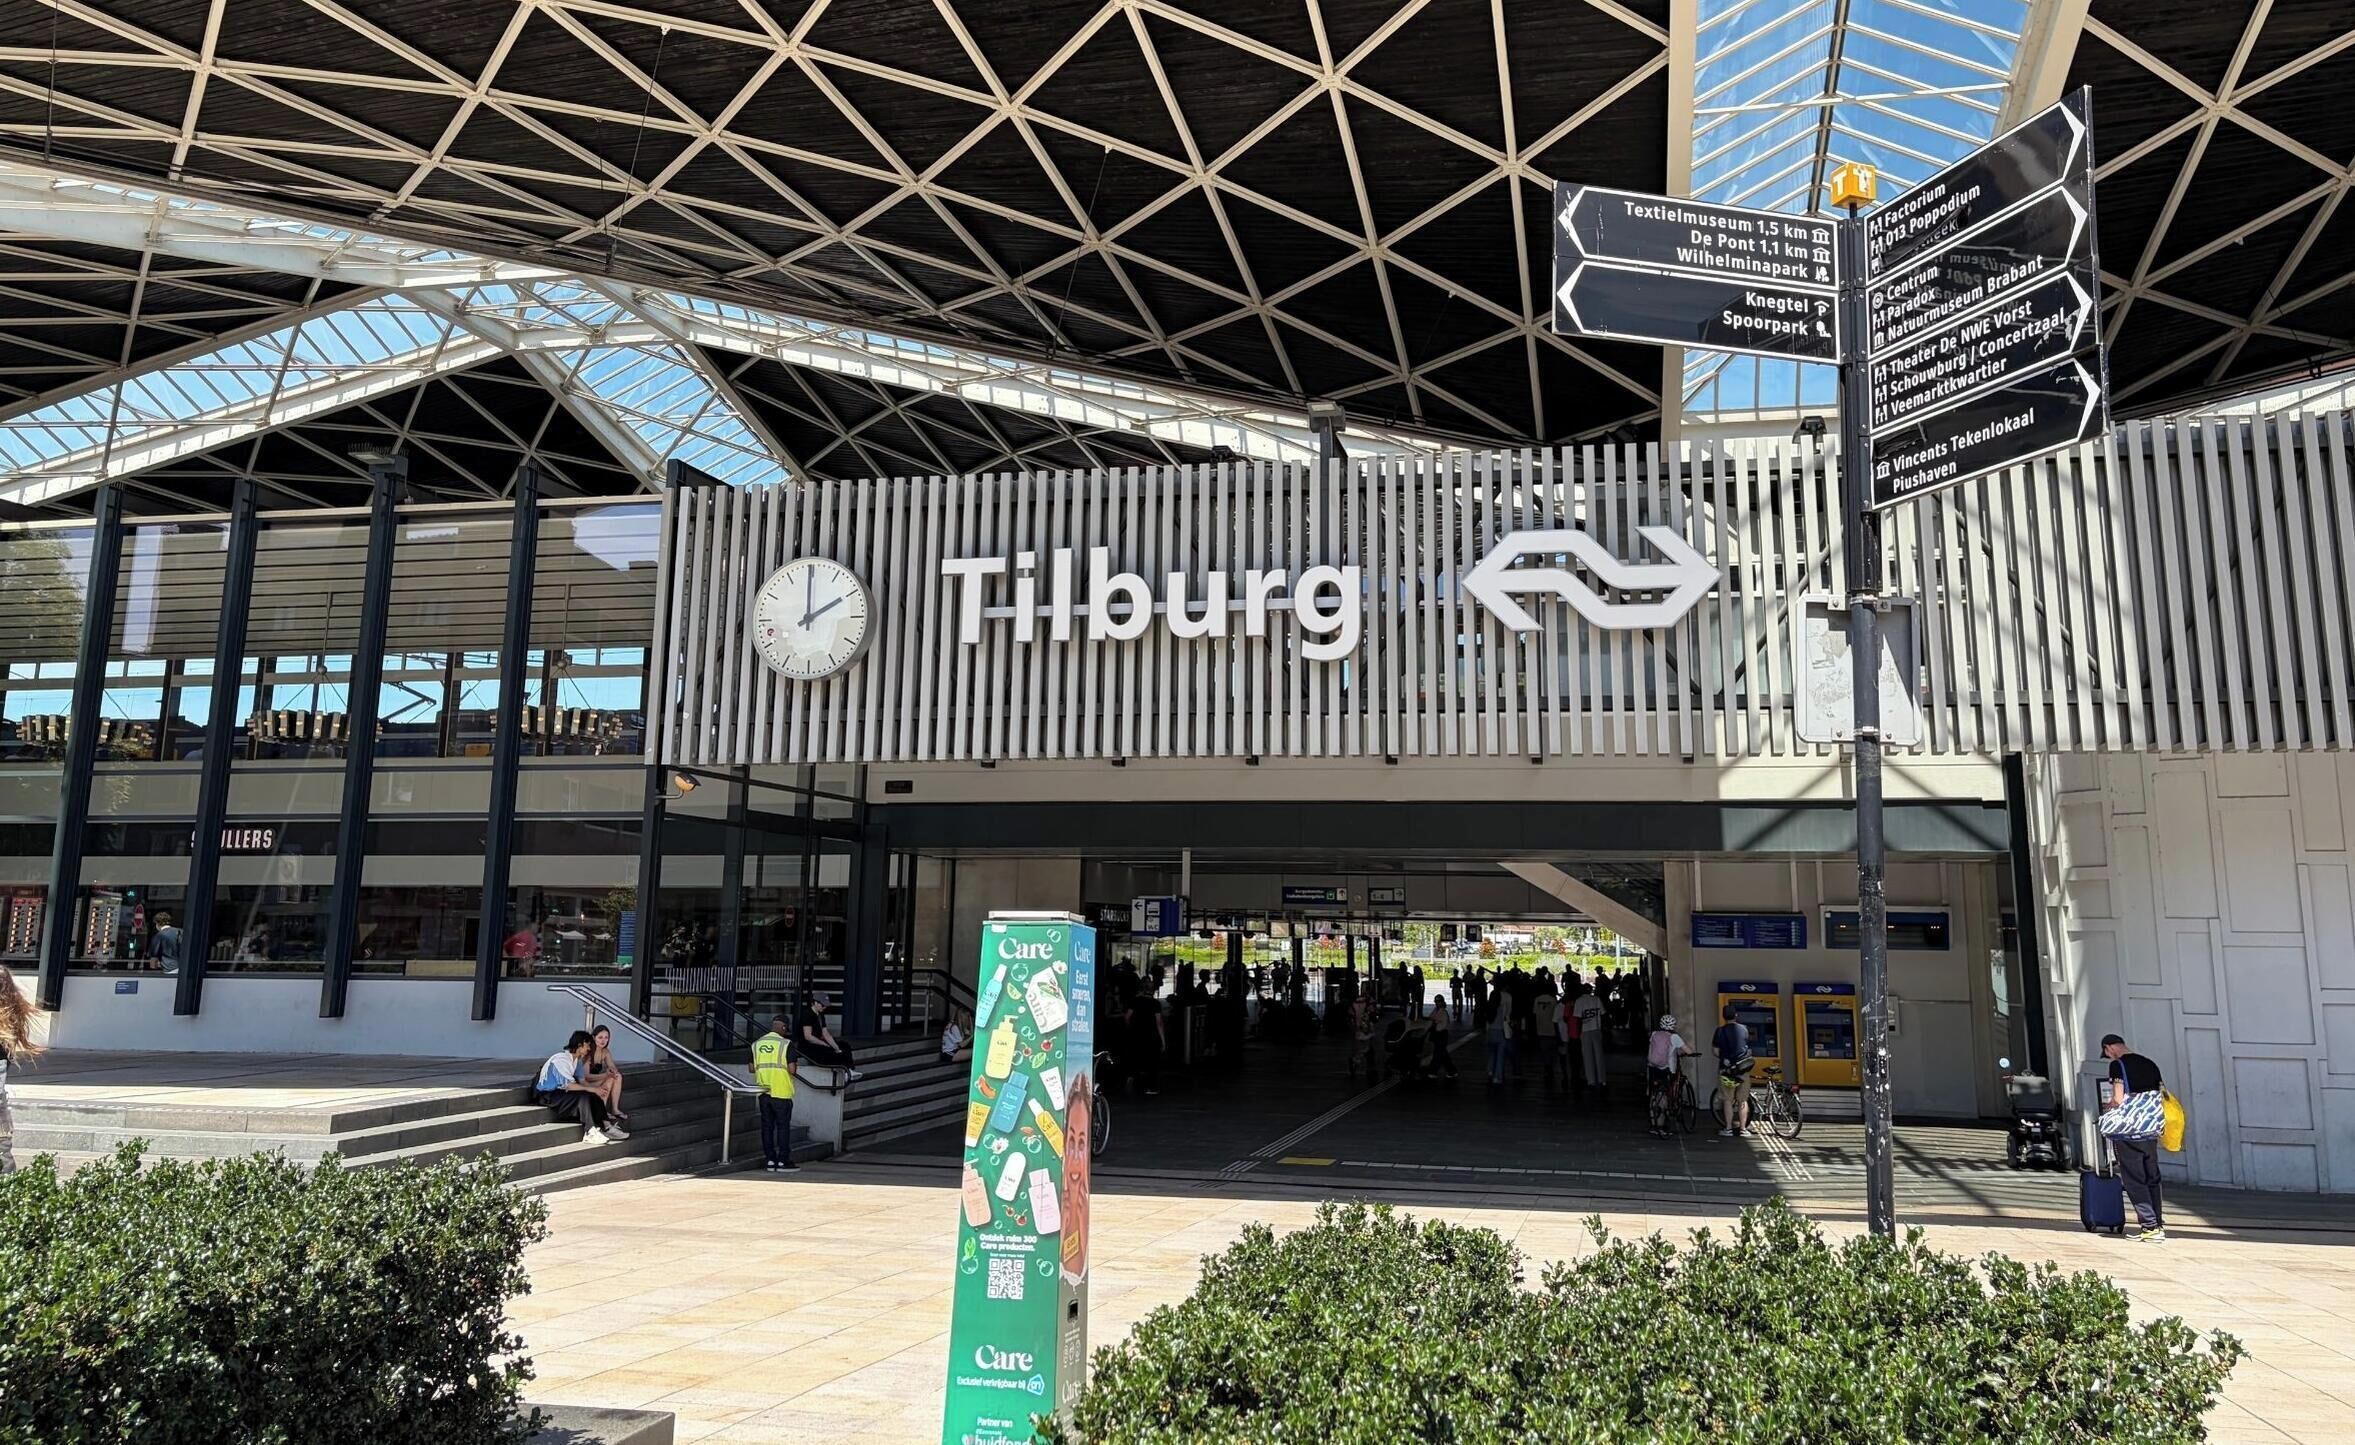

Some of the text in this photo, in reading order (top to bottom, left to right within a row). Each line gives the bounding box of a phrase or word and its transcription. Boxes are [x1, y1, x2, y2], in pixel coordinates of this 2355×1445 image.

[1624, 201, 1808, 240] Textielmuseum 1,5 km
[1885, 184, 1946, 228] Factorium
[1886, 226, 1906, 246] 013
[1909, 185, 1980, 234] Poppodium
[1691, 230, 1808, 259] De Pont 1,1 km
[1676, 247, 1808, 279] Wilhelminapark
[1887, 265, 1938, 300] Centrum
[1888, 285, 1983, 341] Natuurmuseum
[1987, 254, 2044, 294] Brabant
[1746, 292, 1809, 315] Knegtel
[1888, 287, 1936, 320] Paradox
[1723, 311, 1808, 336] Spoorpark
[1890, 300, 2032, 376] Theater De NWE Vorst
[1890, 352, 1967, 396] Schouwburg
[1979, 307, 2065, 356] Concertzaal
[1891, 357, 2008, 416] Veemarktkwartier
[1893, 407, 2035, 473] Vincents Tekenlokaal
[1893, 461, 1957, 494] Piushaven
[941, 546, 1361, 662] Tilburg
[998, 938, 1053, 959] Care
[1074, 941, 1091, 964] Care
[1076, 969, 1088, 986] Eerst
[1076, 1001, 1086, 1017] dan
[980, 1242, 997, 1250] Care
[1023, 1235, 1037, 1244] 300
[975, 1344, 1033, 1371] Care
[957, 1376, 982, 1387] Exclusief
[976, 1416, 1013, 1428] Partner van
